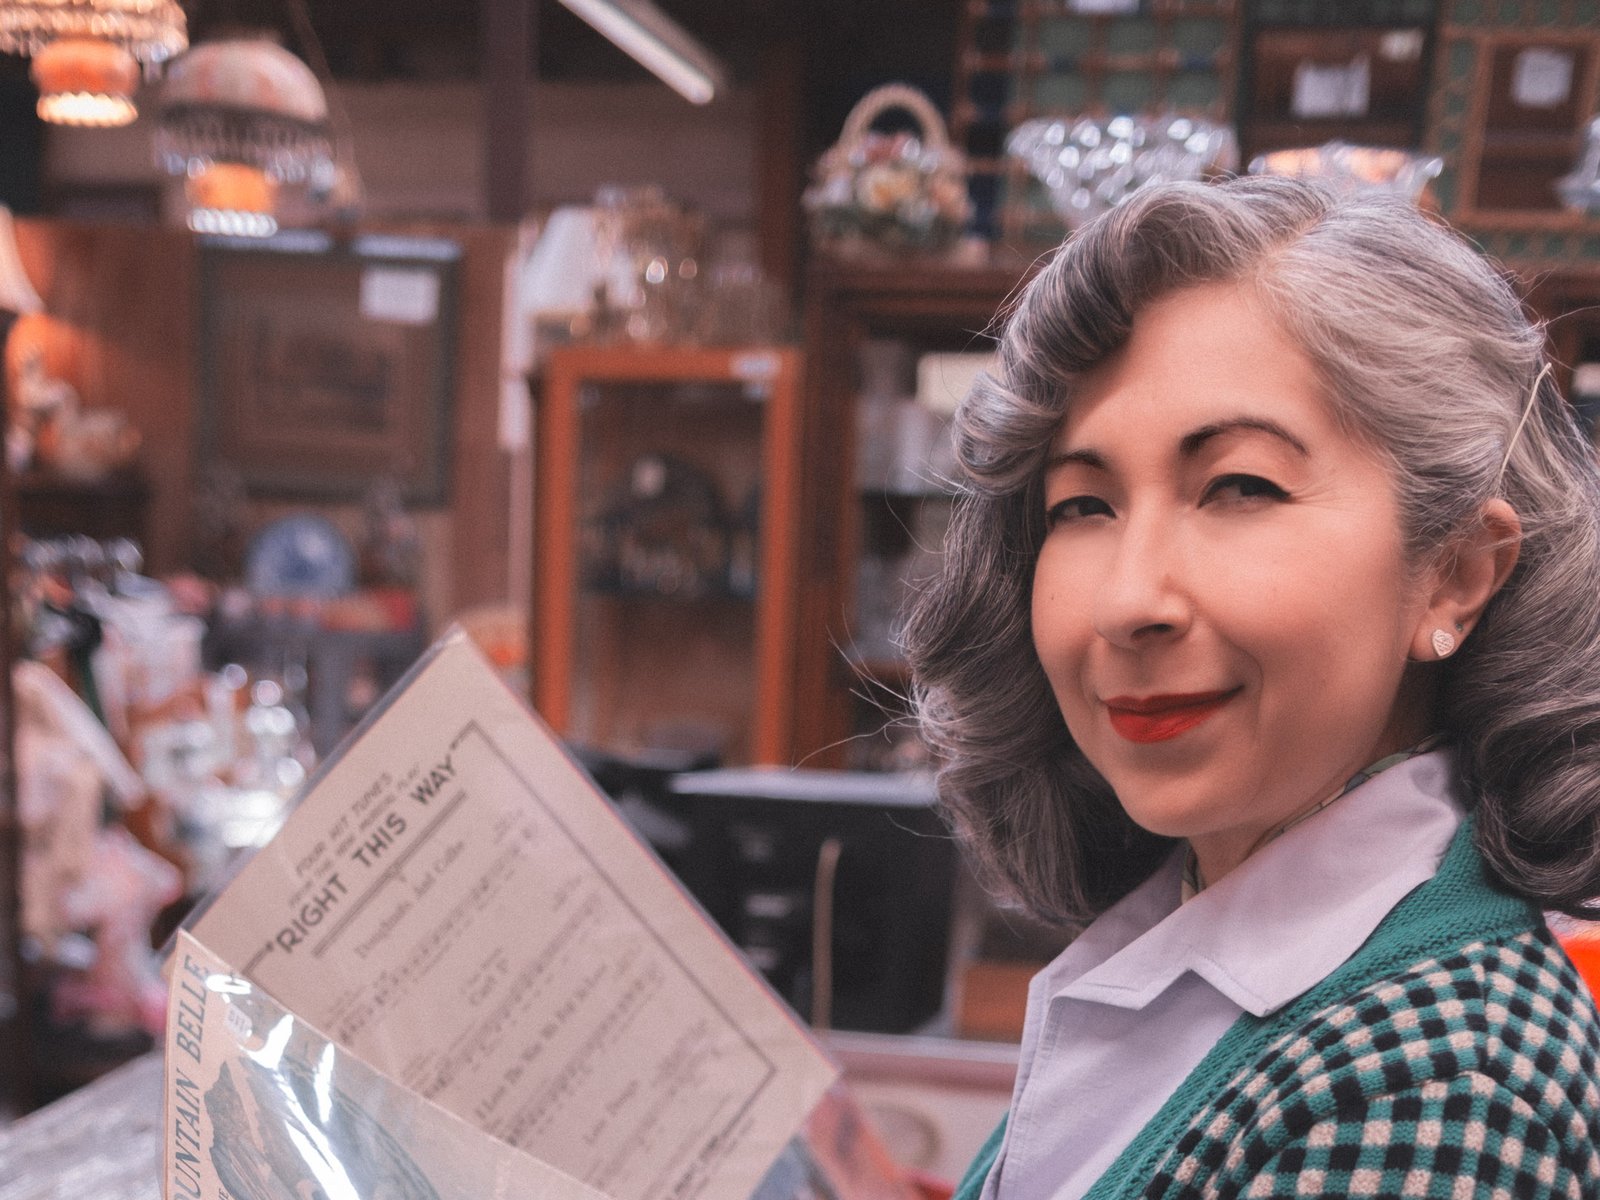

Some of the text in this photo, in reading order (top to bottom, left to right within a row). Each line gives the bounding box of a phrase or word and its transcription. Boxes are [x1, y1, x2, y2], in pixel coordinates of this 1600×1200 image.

[352, 772, 393, 813] TUNES
[275, 754, 457, 953] RIGHT THIS WAY
[176, 955, 209, 1064] BELLE
